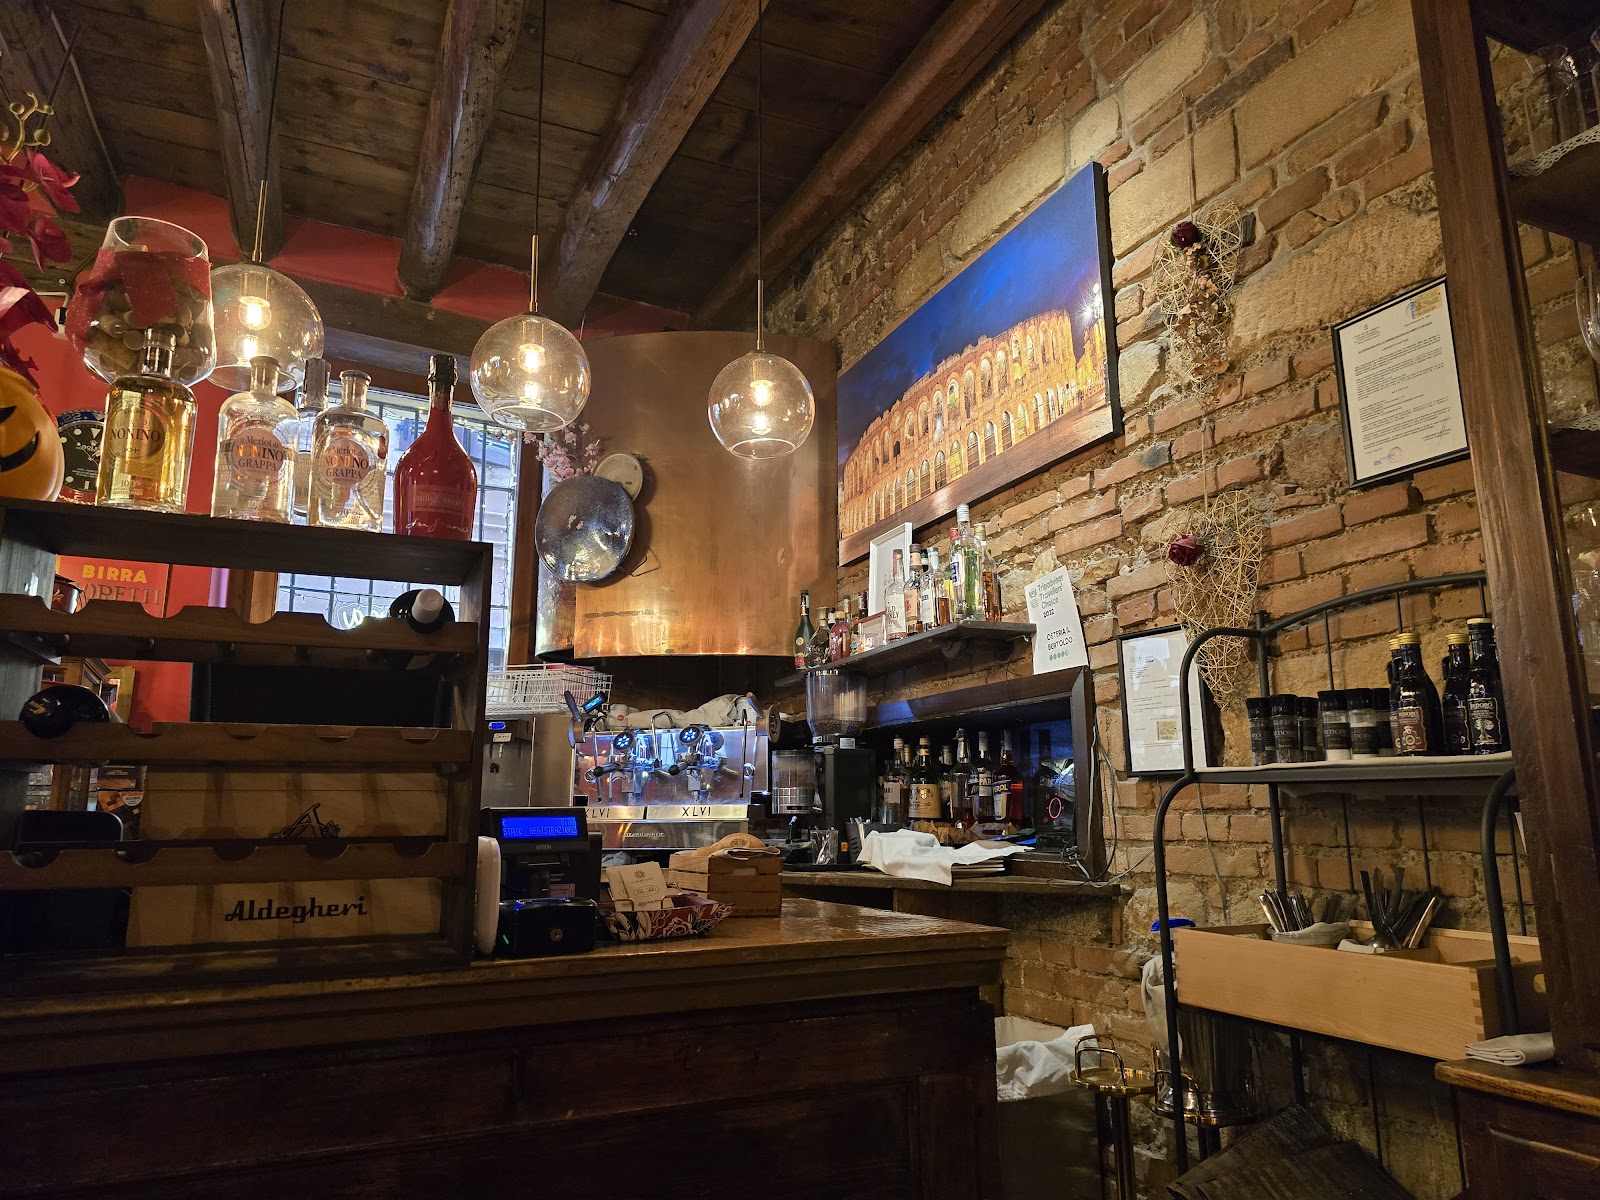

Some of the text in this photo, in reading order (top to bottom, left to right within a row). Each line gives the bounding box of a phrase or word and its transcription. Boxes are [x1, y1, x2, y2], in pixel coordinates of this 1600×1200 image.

[109, 427, 161, 443] NONINO
[246, 435, 272, 447] Merlot
[236, 444, 285, 464] NONINO
[238, 457, 278, 472] GRAPPA
[324, 455, 369, 470] NONINO
[325, 467, 362, 479] GRAPPA
[81, 564, 148, 584] BIRRA
[1037, 574, 1064, 592] Tripadvisor
[78, 582, 161, 606] ORETTI
[1041, 596, 1060, 610] Choice
[1042, 608, 1056, 619] 2022
[1046, 627, 1068, 641] OSTERIA
[1047, 636, 1073, 651] BERTOLDO
[681, 806, 711, 817] XLVI
[502, 826, 577, 836] STATO REGISTRAZIONE
[224, 895, 368, 924] Aldegheri
